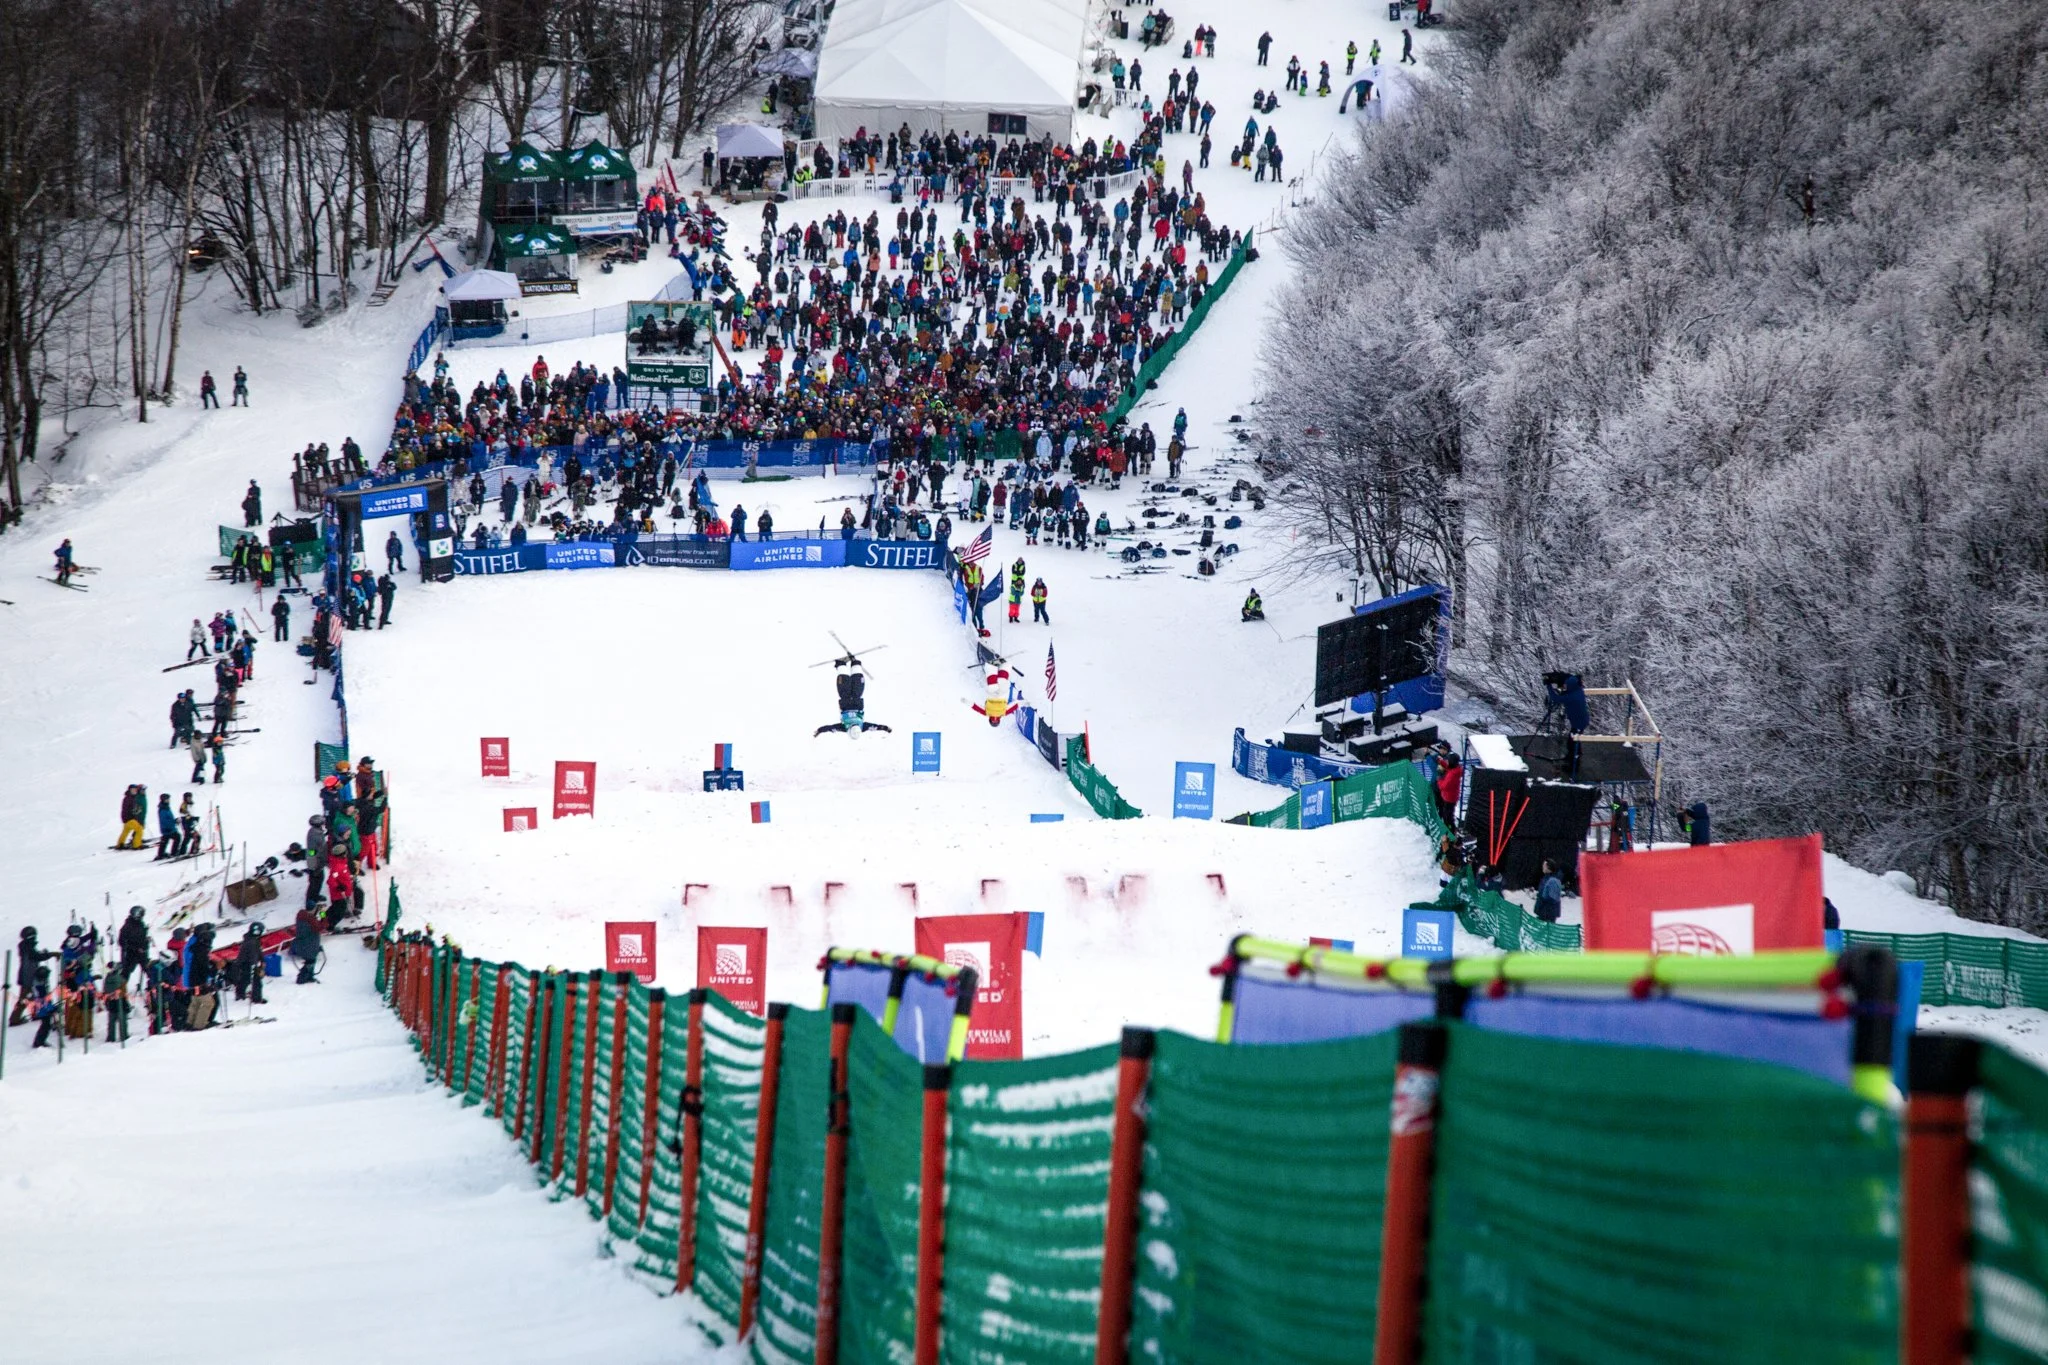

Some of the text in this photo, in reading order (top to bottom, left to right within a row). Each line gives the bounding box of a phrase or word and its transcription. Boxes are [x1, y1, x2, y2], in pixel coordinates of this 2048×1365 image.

[524, 283, 572, 293] NATIONAL GUARD
[630, 374, 686, 384] National Forest
[374, 496, 408, 506] UNITED
[367, 502, 409, 513] AIRLINES
[556, 548, 597, 557] UNITED
[763, 546, 804, 556] UNITED
[865, 543, 939, 567] STIFEL
[453, 551, 527, 574] STIFEL
[548, 555, 598, 564] AIRLINES
[754, 553, 804, 563] AIRLINES
[1410, 944, 1444, 952] UNITED
[709, 976, 754, 985] UNITED
